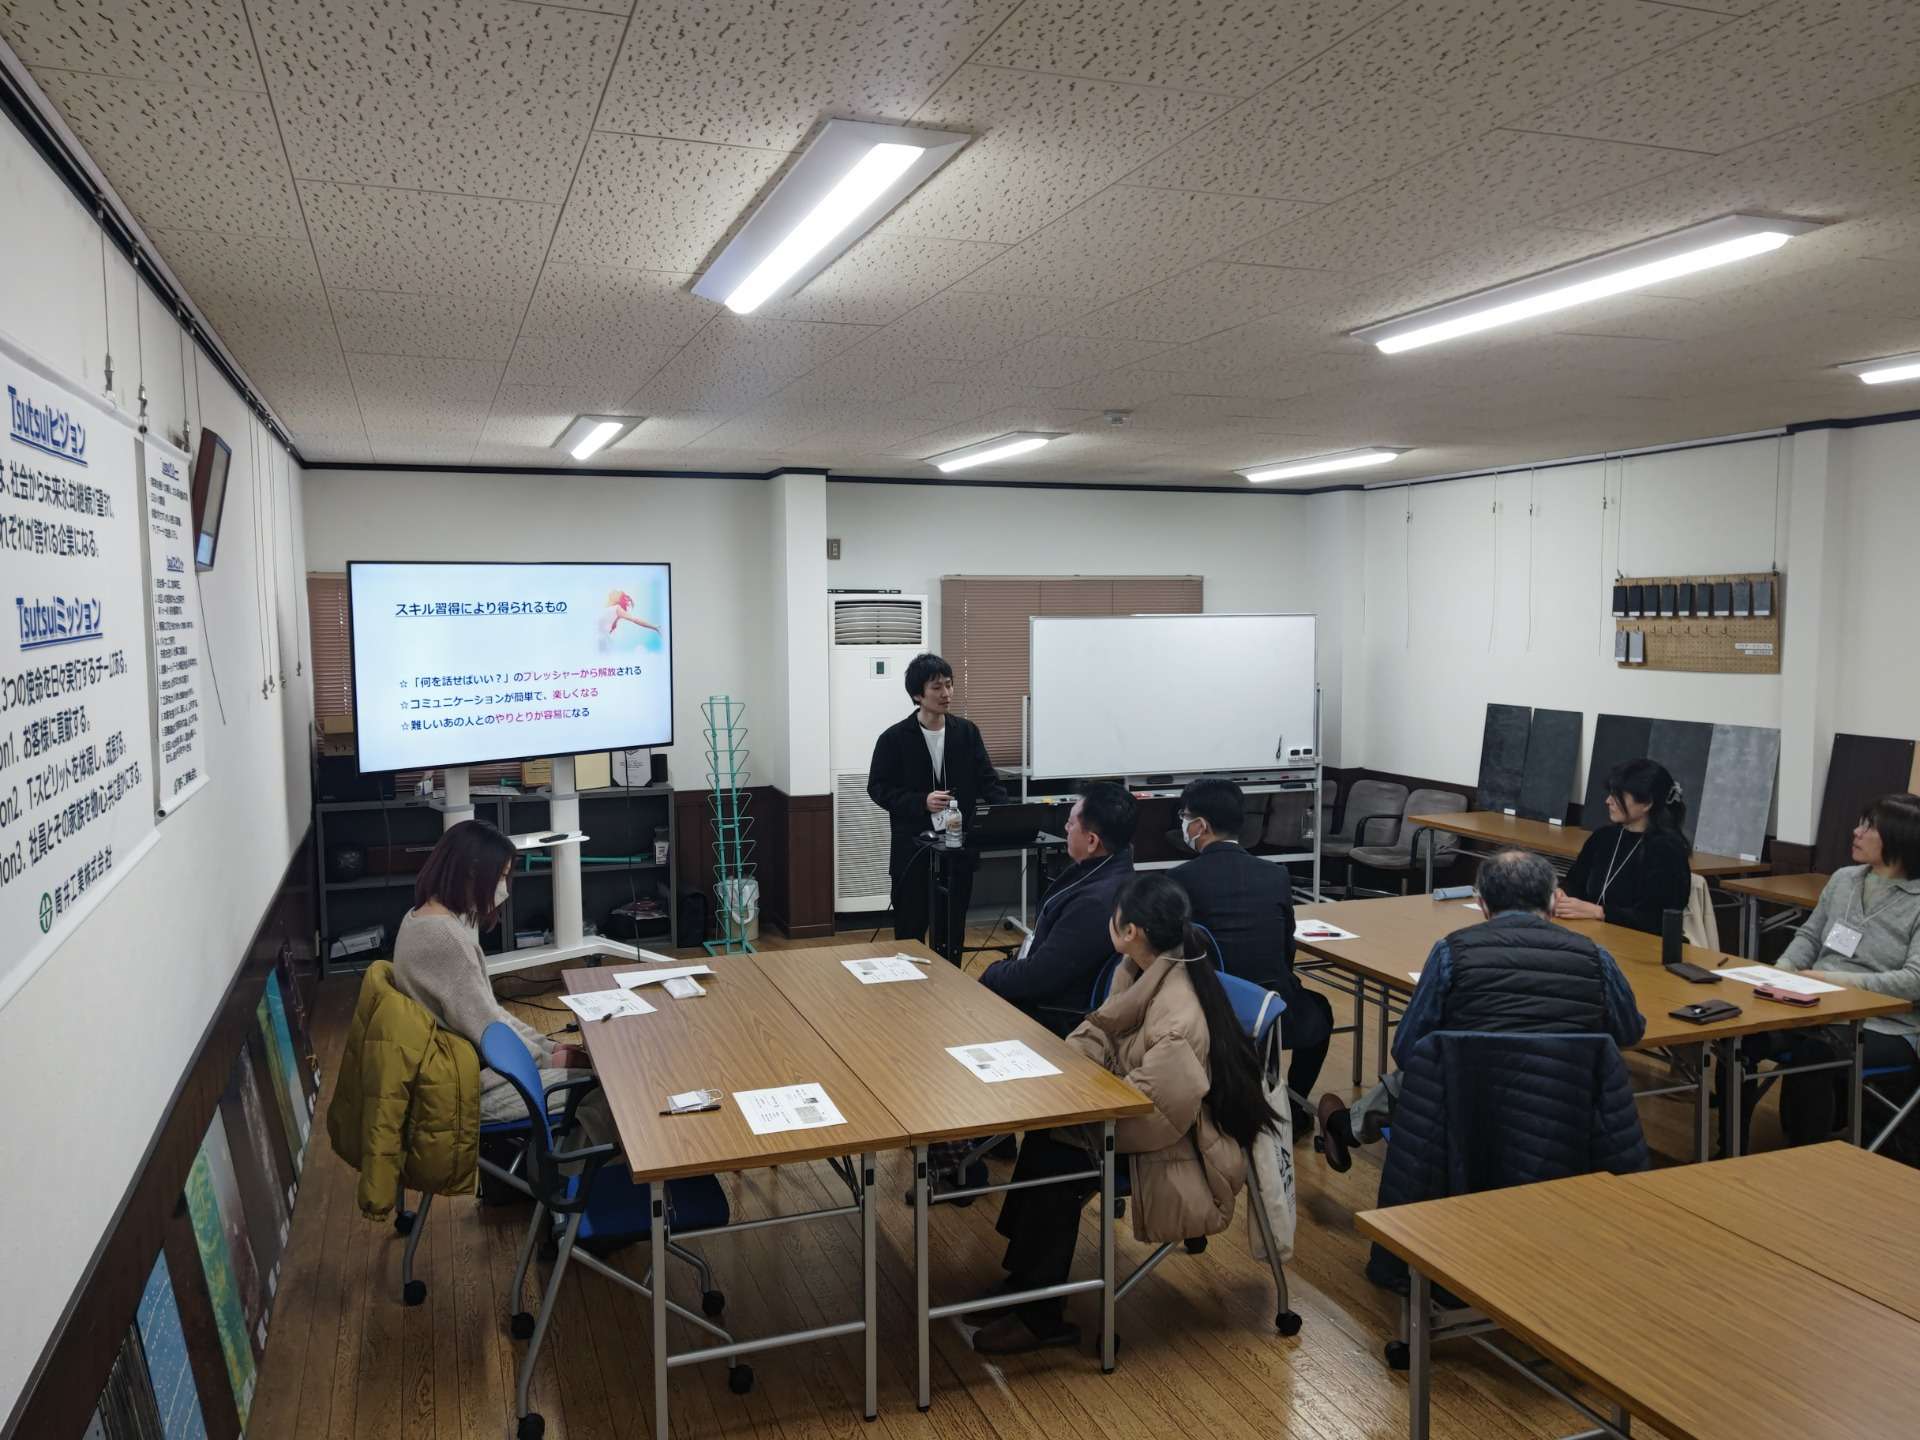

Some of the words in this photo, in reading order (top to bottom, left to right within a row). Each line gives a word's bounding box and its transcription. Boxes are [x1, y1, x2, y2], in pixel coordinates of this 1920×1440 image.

[7, 384, 86, 454] Tsutsuiビジョン
[16, 596, 102, 639] Tsutsuiミッション
[395, 601, 568, 616] スキル習得により得られるもの
[55, 845, 113, 917] 筒井工業株式会社
